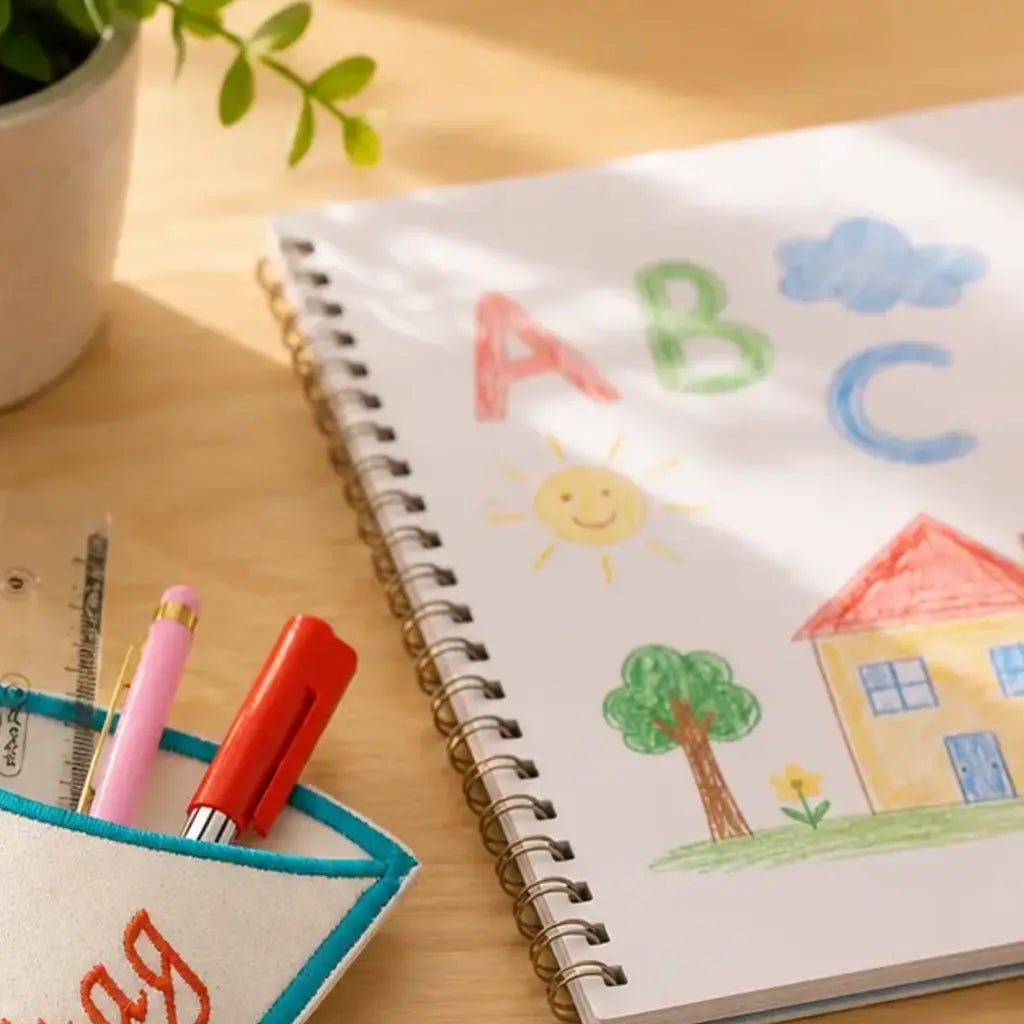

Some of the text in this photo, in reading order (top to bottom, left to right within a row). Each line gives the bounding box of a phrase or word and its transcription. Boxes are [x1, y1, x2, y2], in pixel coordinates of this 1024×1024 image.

[474, 258, 978, 466] A B C
